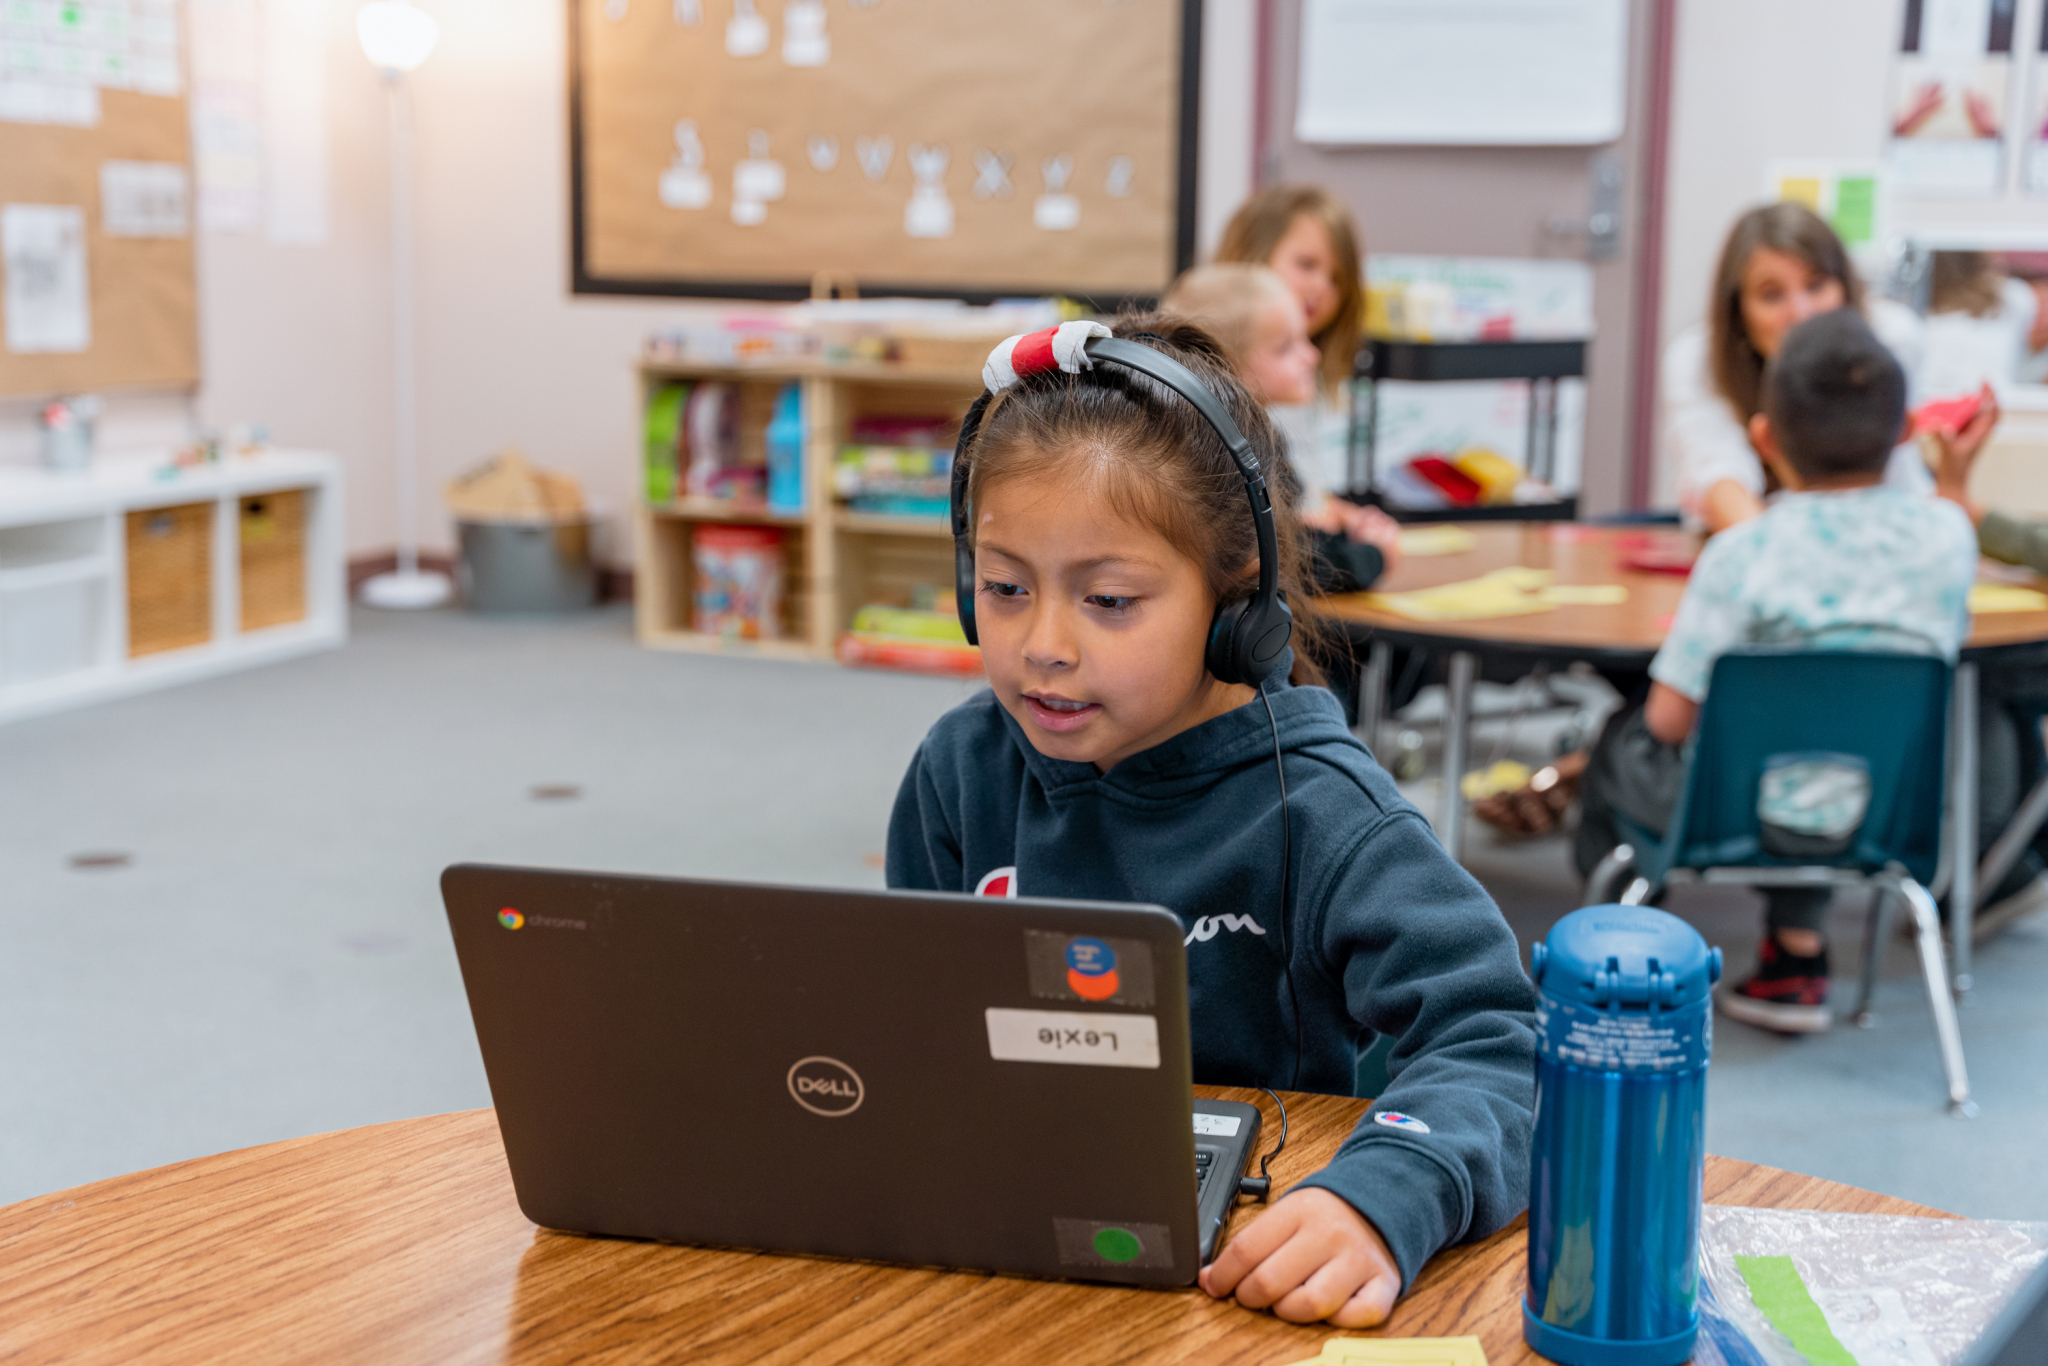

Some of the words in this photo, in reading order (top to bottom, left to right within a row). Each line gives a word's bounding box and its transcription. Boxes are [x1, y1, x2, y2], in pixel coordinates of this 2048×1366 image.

[1184, 913, 1266, 947] on
[1038, 1027, 1118, 1051] Lexie
[797, 1077, 857, 1098] DELL
